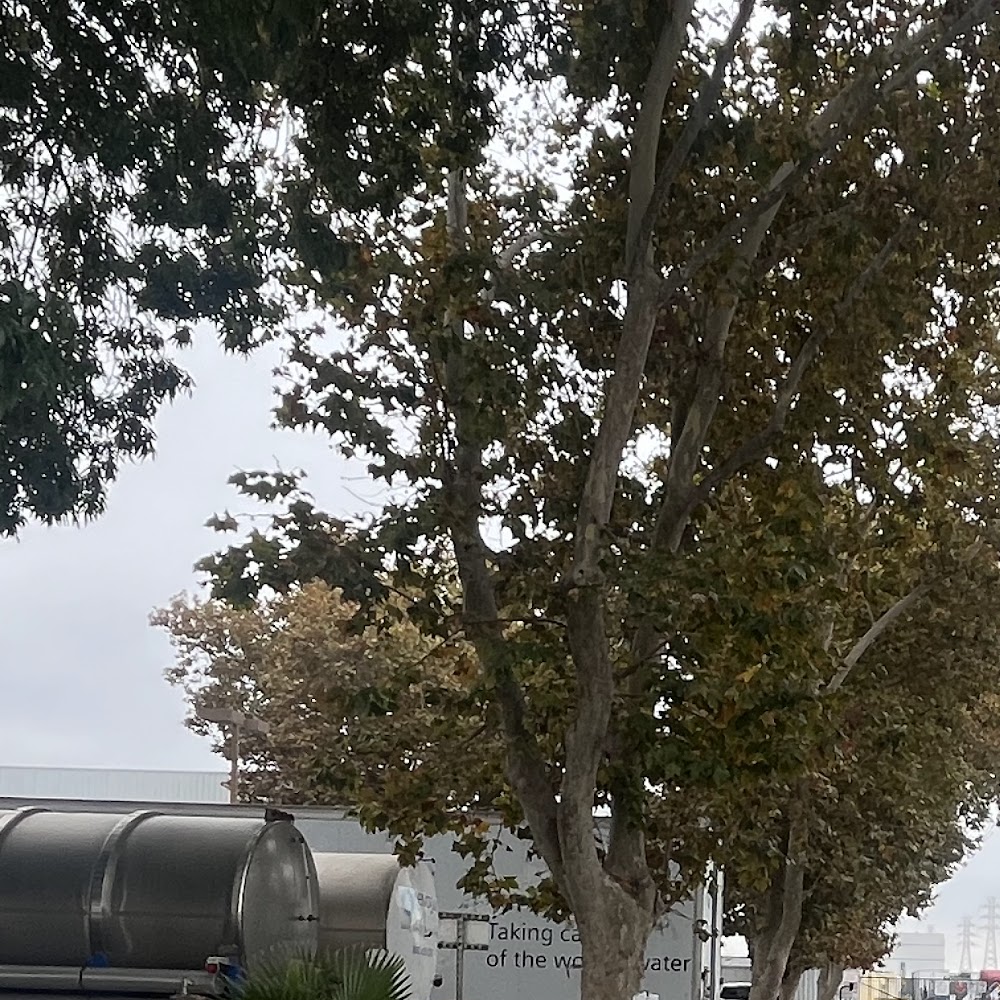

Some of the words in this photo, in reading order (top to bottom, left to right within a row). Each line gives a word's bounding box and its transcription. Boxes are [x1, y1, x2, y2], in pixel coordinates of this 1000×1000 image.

[489, 922, 553, 946] Taking
[560, 927, 583, 942] ca
[486, 949, 507, 968] of
[514, 951, 547, 969] the
[643, 956, 692, 972] ater
